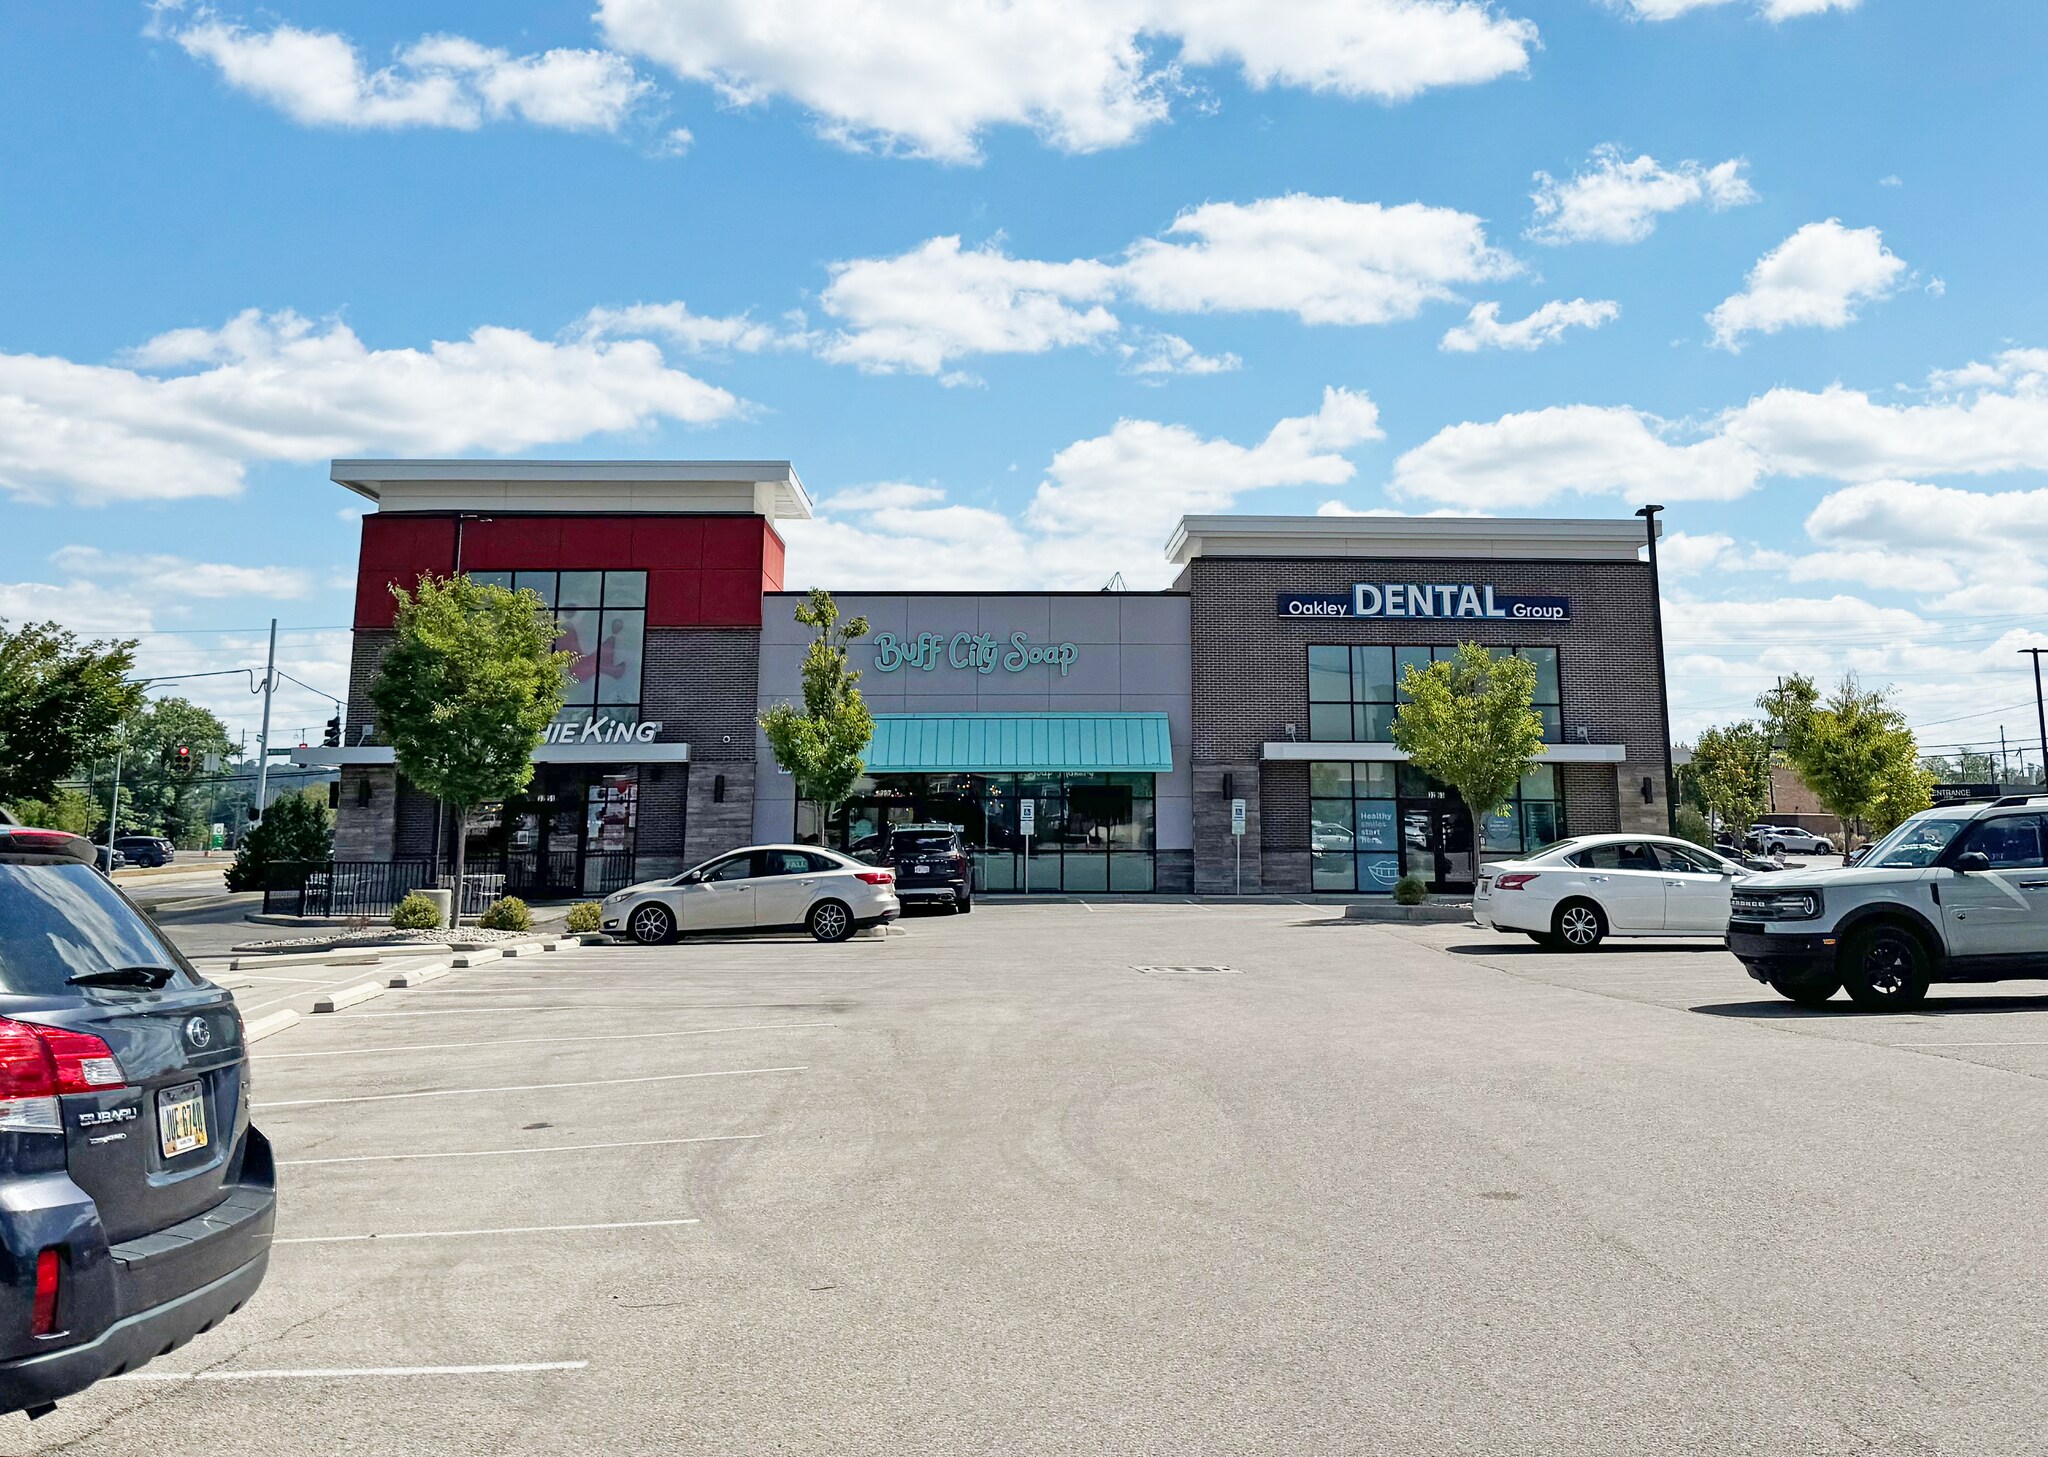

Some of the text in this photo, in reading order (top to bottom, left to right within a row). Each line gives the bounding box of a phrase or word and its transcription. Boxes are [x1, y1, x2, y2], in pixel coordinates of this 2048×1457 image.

[1288, 583, 1563, 619] Oakley DENTAL Group
[874, 631, 1080, 676] Buff City Soap
[1932, 789, 1971, 797] ENTRANCE
[1360, 812, 1392, 820] Healthy
[79, 1107, 137, 1126] SUBARU
